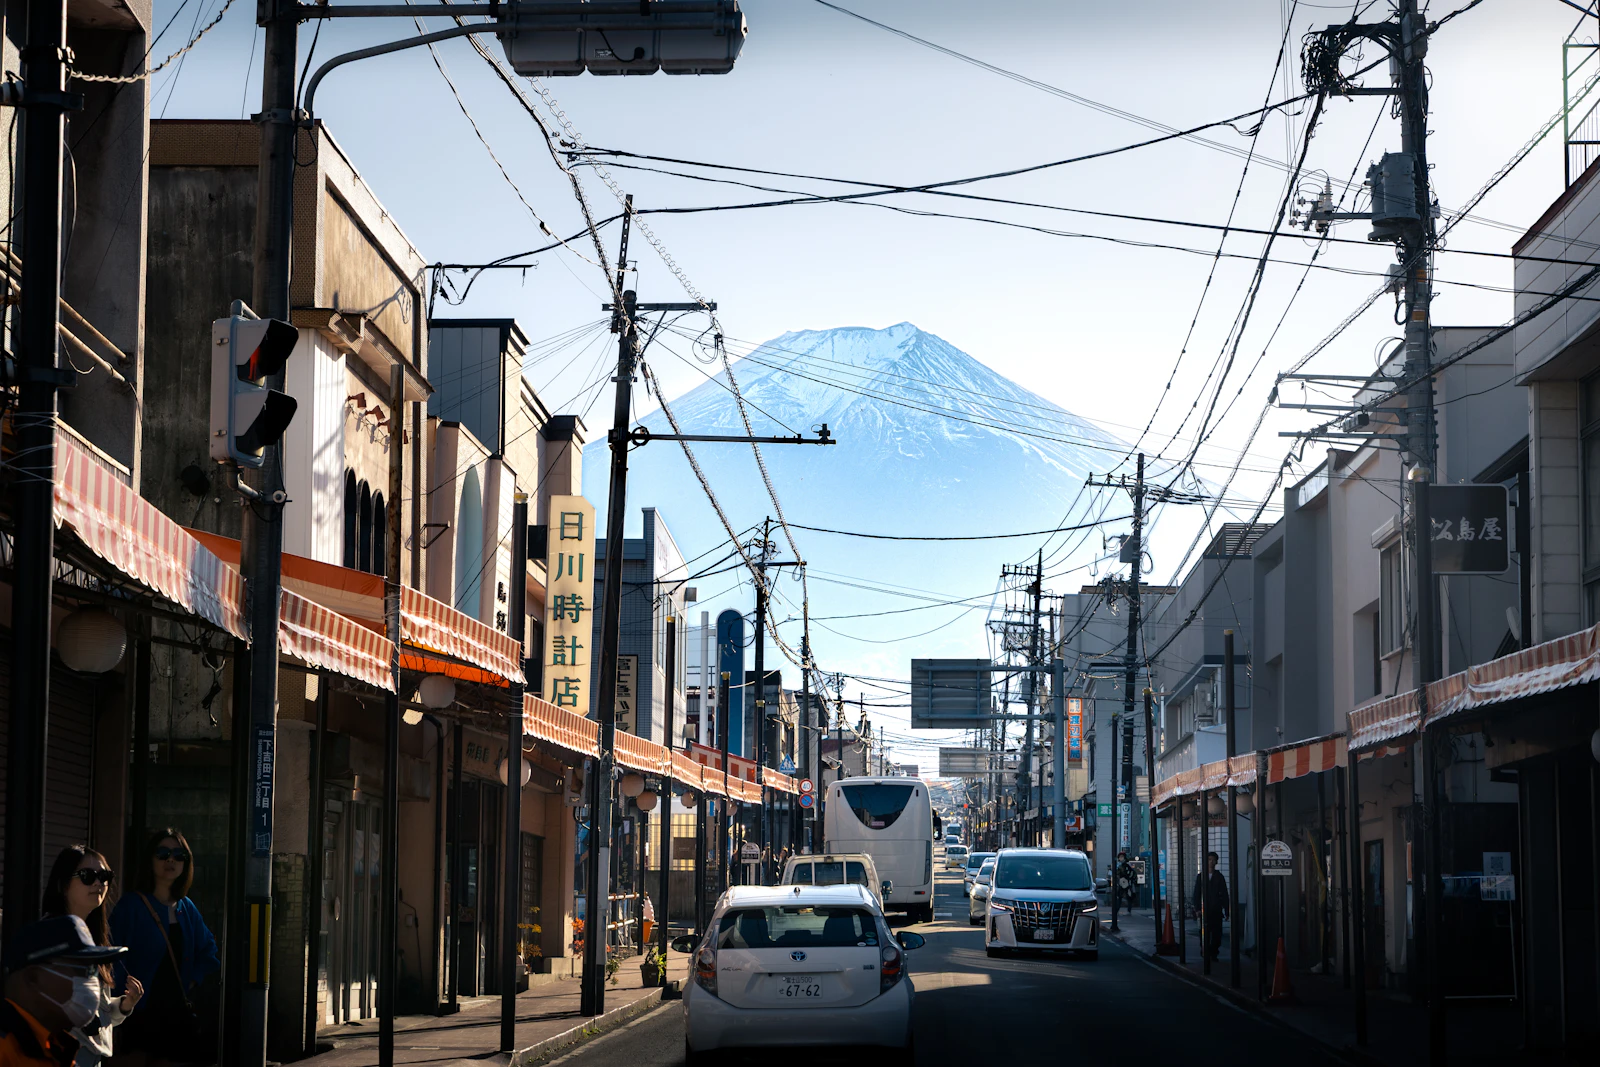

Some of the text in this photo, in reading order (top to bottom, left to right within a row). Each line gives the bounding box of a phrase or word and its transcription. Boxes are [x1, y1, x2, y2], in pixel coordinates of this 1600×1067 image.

[551, 511, 584, 707] 日川時計店
[262, 739, 272, 808] 下吉田二丁目
[261, 813, 267, 826] 1
[786, 984, 820, 997] 67-62
